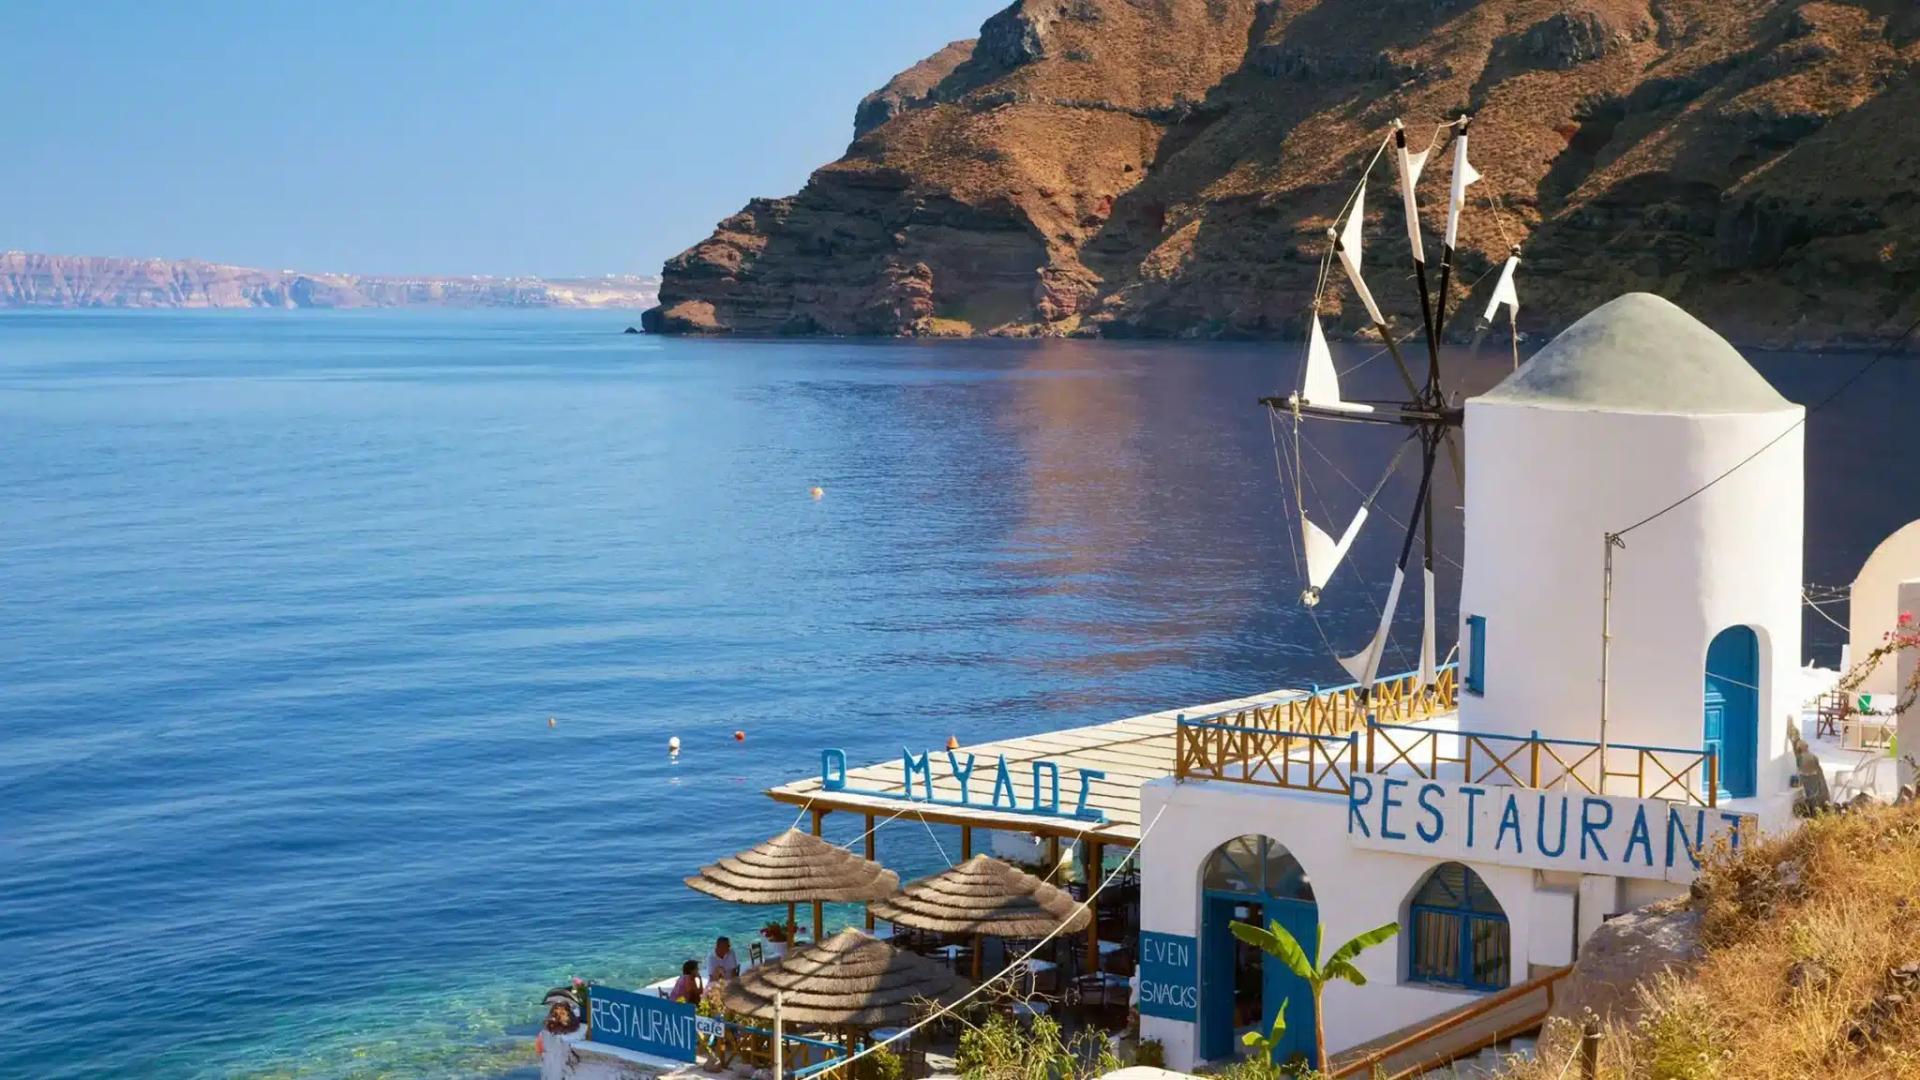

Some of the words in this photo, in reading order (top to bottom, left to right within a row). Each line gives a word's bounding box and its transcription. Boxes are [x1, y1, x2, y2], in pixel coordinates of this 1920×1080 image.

[903, 746, 1106, 823] ΜΥΛΟΣ
[1348, 776, 1745, 869] RESTAURANT
[1144, 938, 1189, 968] EVEN
[1140, 980, 1197, 1009] SNACKS
[590, 998, 694, 1050] RESTAURANT
